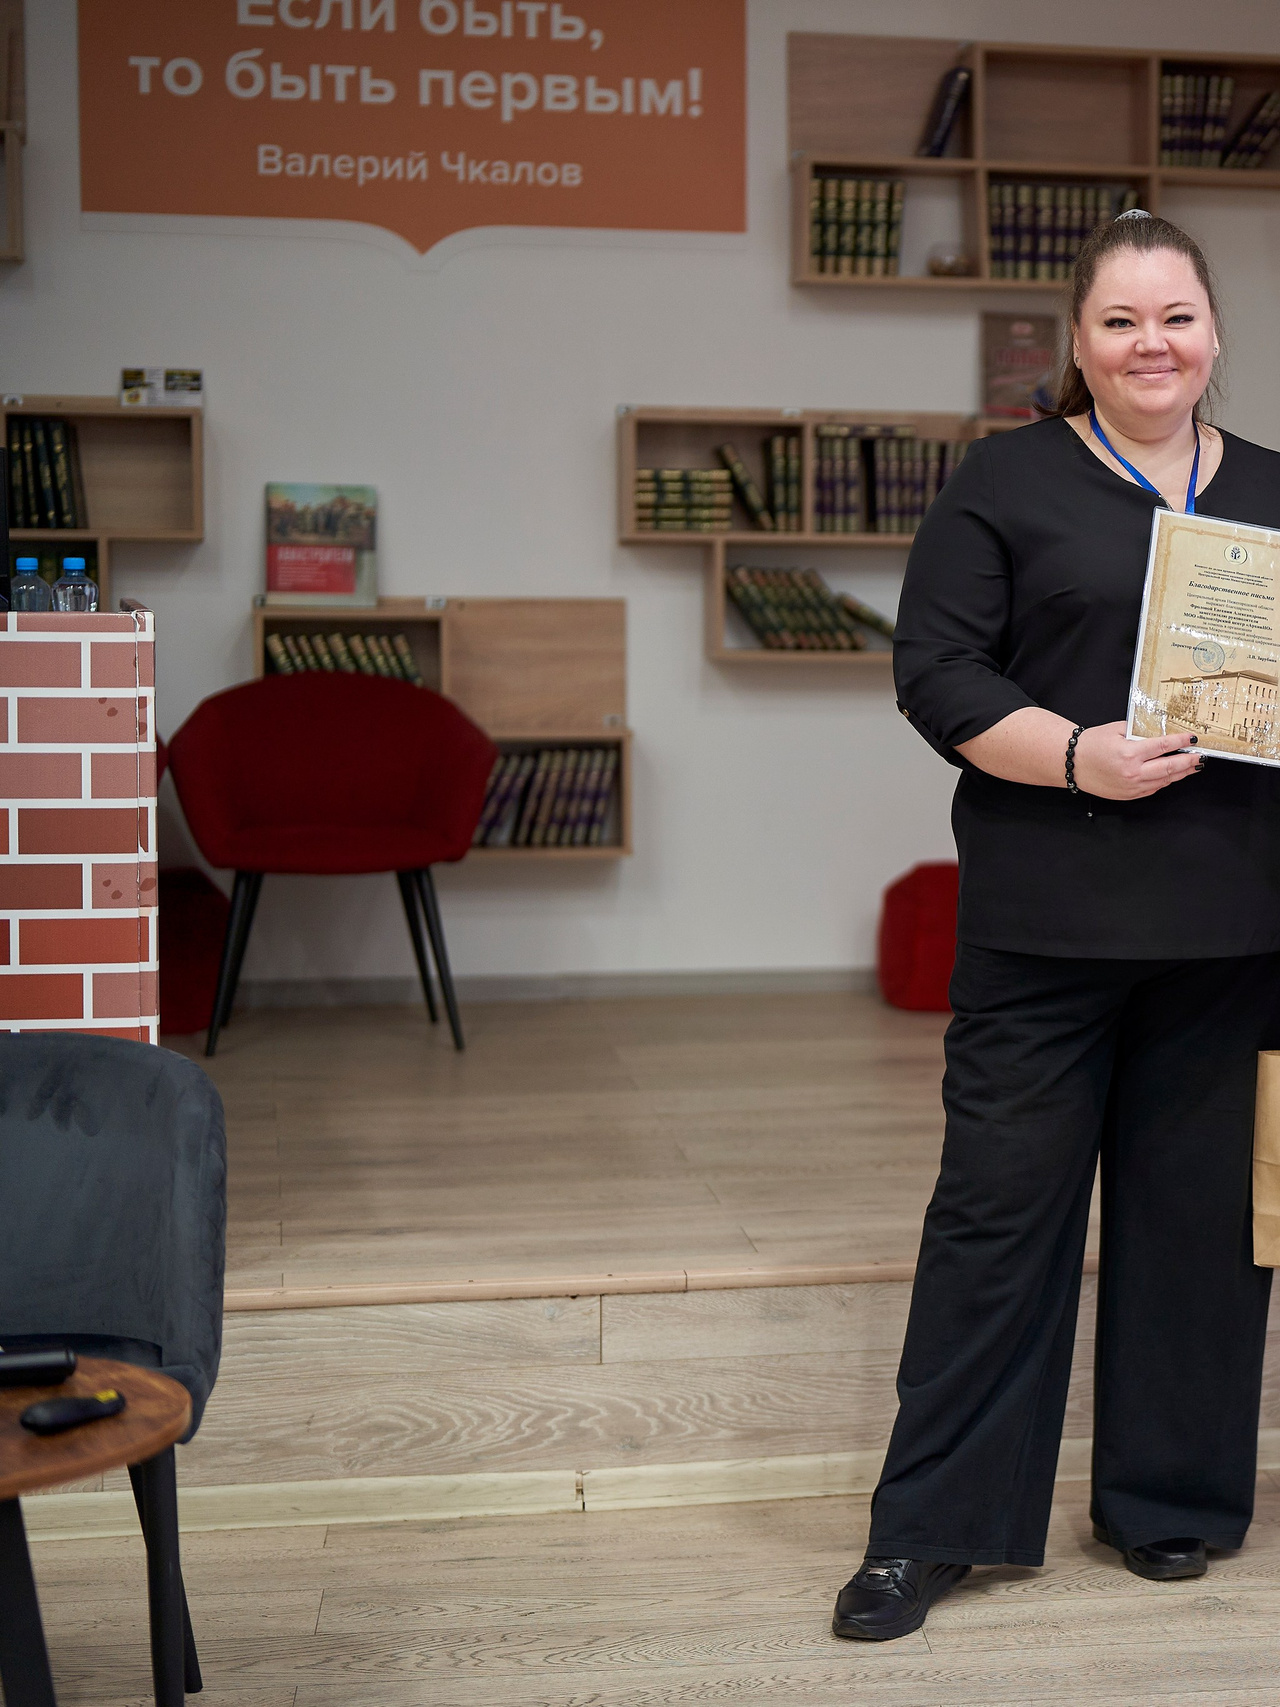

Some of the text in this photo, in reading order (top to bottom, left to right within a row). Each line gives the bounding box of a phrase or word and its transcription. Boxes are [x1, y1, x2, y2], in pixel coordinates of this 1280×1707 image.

[419, 0, 604, 50] быть,
[128, 48, 703, 123] то быть первым!
[257, 144, 583, 187] Валерий Чкалов
[1188, 580, 1275, 602] Благодарственное письмо
